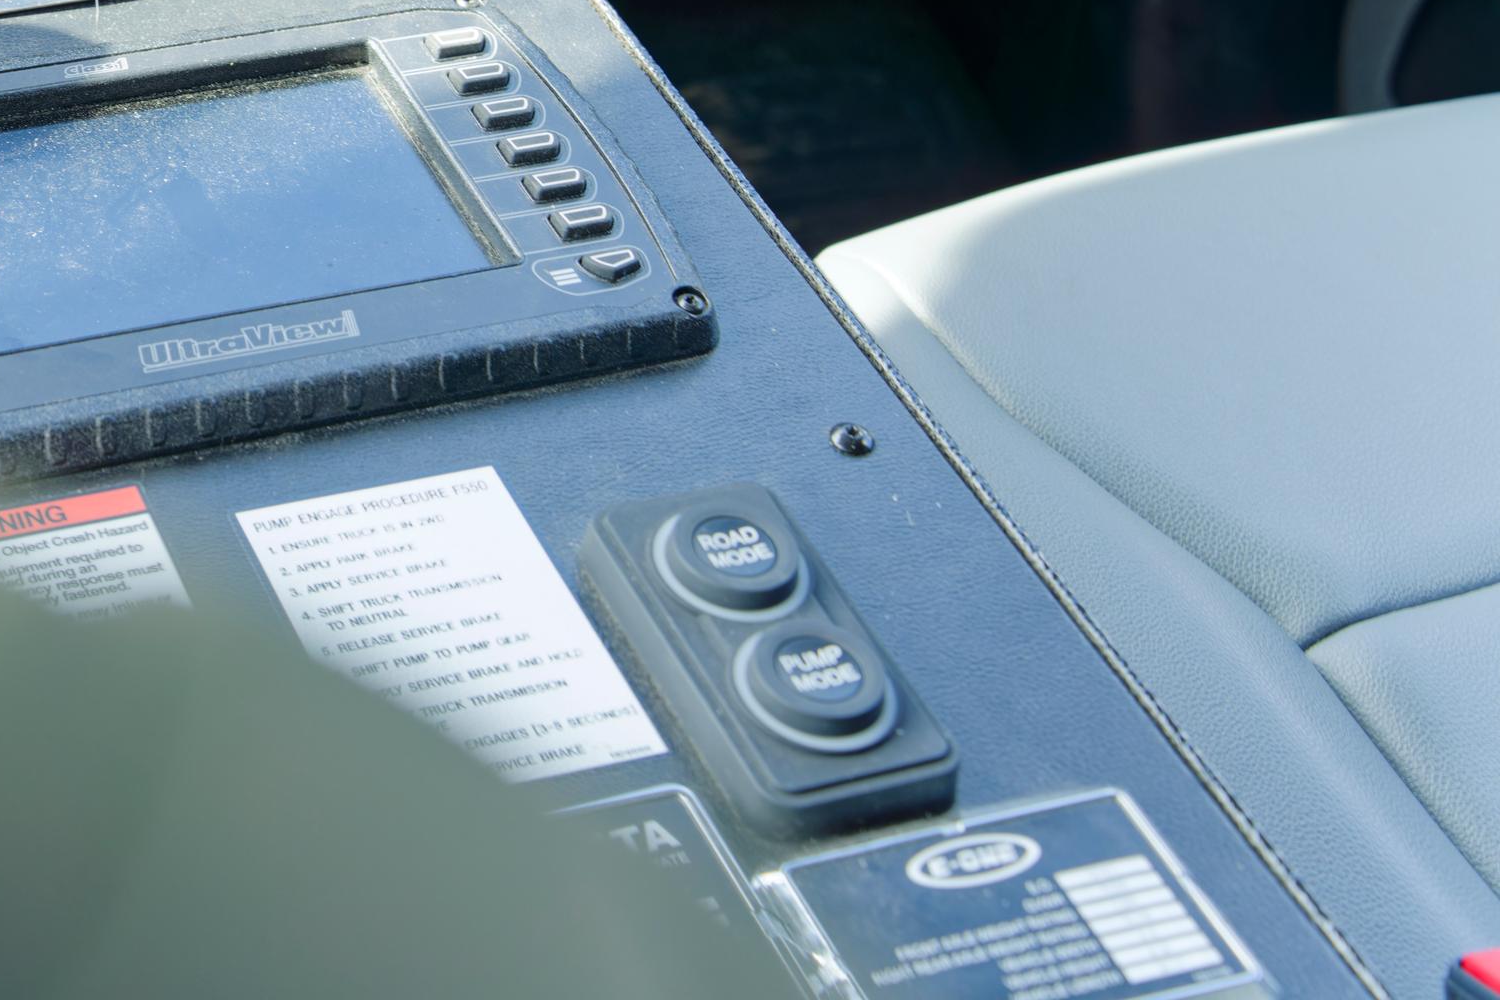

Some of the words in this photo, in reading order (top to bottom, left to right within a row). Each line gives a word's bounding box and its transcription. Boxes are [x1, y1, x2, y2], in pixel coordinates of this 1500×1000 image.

[138, 312, 359, 370] UltraView
[253, 516, 293, 533] PUMP
[298, 504, 358, 524] ENGAGE
[362, 488, 448, 513] PROCEDURE
[451, 479, 489, 497] F550
[2, 540, 49, 558] Object
[51, 531, 97, 547] Crash
[99, 520, 150, 539] Hazard
[281, 535, 331, 553] ENSURE
[338, 526, 376, 542] TRUCK
[696, 525, 760, 551] ROAD
[65, 546, 127, 567] required
[127, 543, 145, 554] to
[296, 560, 332, 574] APPLY
[337, 552, 369, 566] PARK
[374, 543, 416, 558] BRAKE
[707, 542, 776, 569] MODE
[27, 567, 78, 587] during
[79, 564, 99, 576] an
[56, 569, 126, 592] response
[127, 562, 165, 579] must
[306, 580, 342, 595] APPLY
[347, 568, 400, 586] SERVICE
[406, 559, 448, 575] BRAKE
[62, 581, 132, 603] fastened.
[317, 602, 356, 619] SHIFT
[359, 592, 404, 609] TRUCK
[407, 573, 504, 600] TRANSMISSION
[326, 620, 345, 632] TO
[348, 608, 410, 628] NEUTRAL
[336, 633, 397, 653] RELEASE
[400, 622, 456, 641] SERVICE
[460, 611, 504, 628] BRAKE
[351, 661, 390, 679] SHIFT
[393, 653, 430, 670] PUMP
[433, 648, 453, 660] TO
[455, 639, 491, 656] PUMP
[496, 632, 532, 647] GEAR
[408, 672, 465, 694] SERVICE
[468, 662, 513, 680] BRAKE
[517, 656, 545, 669] AND
[549, 648, 584, 664] HOLD
[778, 645, 843, 674] PUMP
[790, 662, 862, 693] MODE
[419, 700, 471, 719] TRUCK
[470, 679, 569, 708] TRANSMISSION
[465, 727, 530, 750] ENGAGES
[539, 743, 587, 763] BRAKE
[926, 842, 1019, 879] E-ONE
